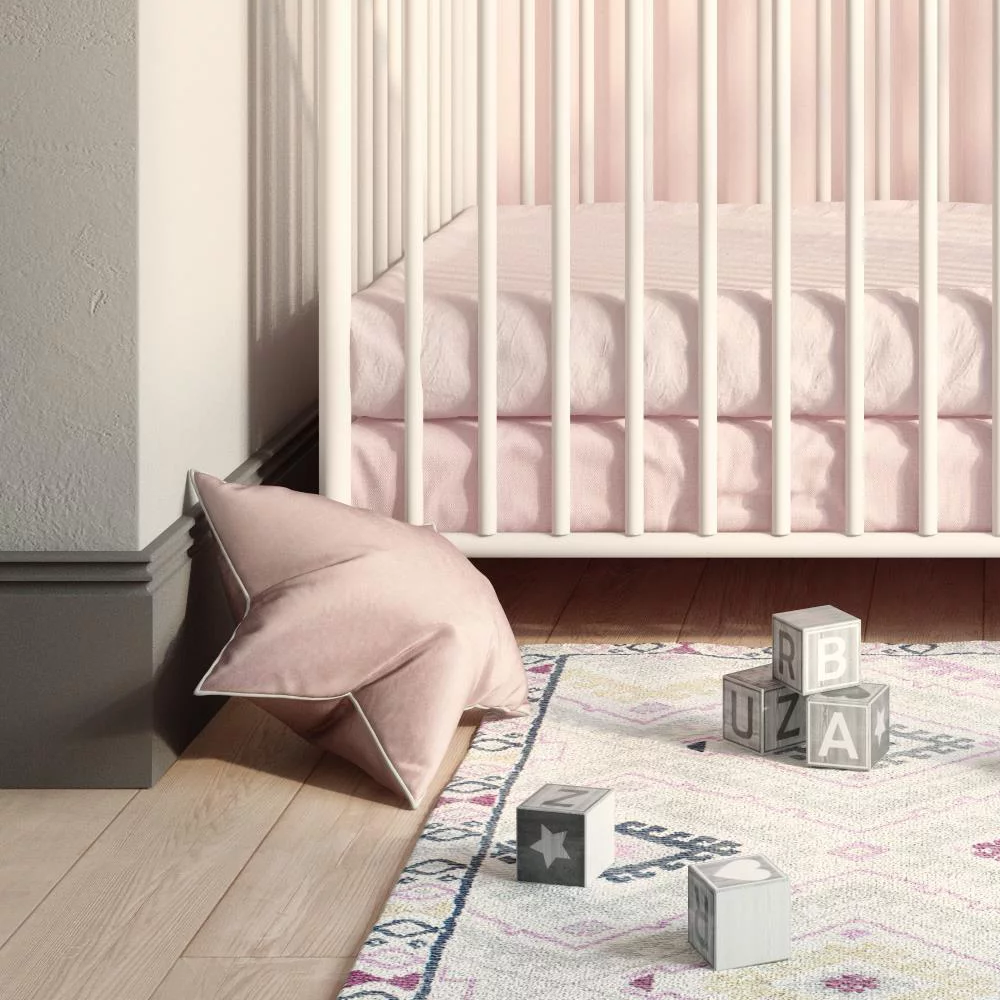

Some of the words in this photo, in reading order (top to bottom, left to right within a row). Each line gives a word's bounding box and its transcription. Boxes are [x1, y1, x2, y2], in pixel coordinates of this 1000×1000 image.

[779, 629, 795, 680] R
[818, 637, 846, 682] B
[732, 689, 753, 739] U
[776, 693, 800, 741] Z
[818, 711, 859, 760] A
